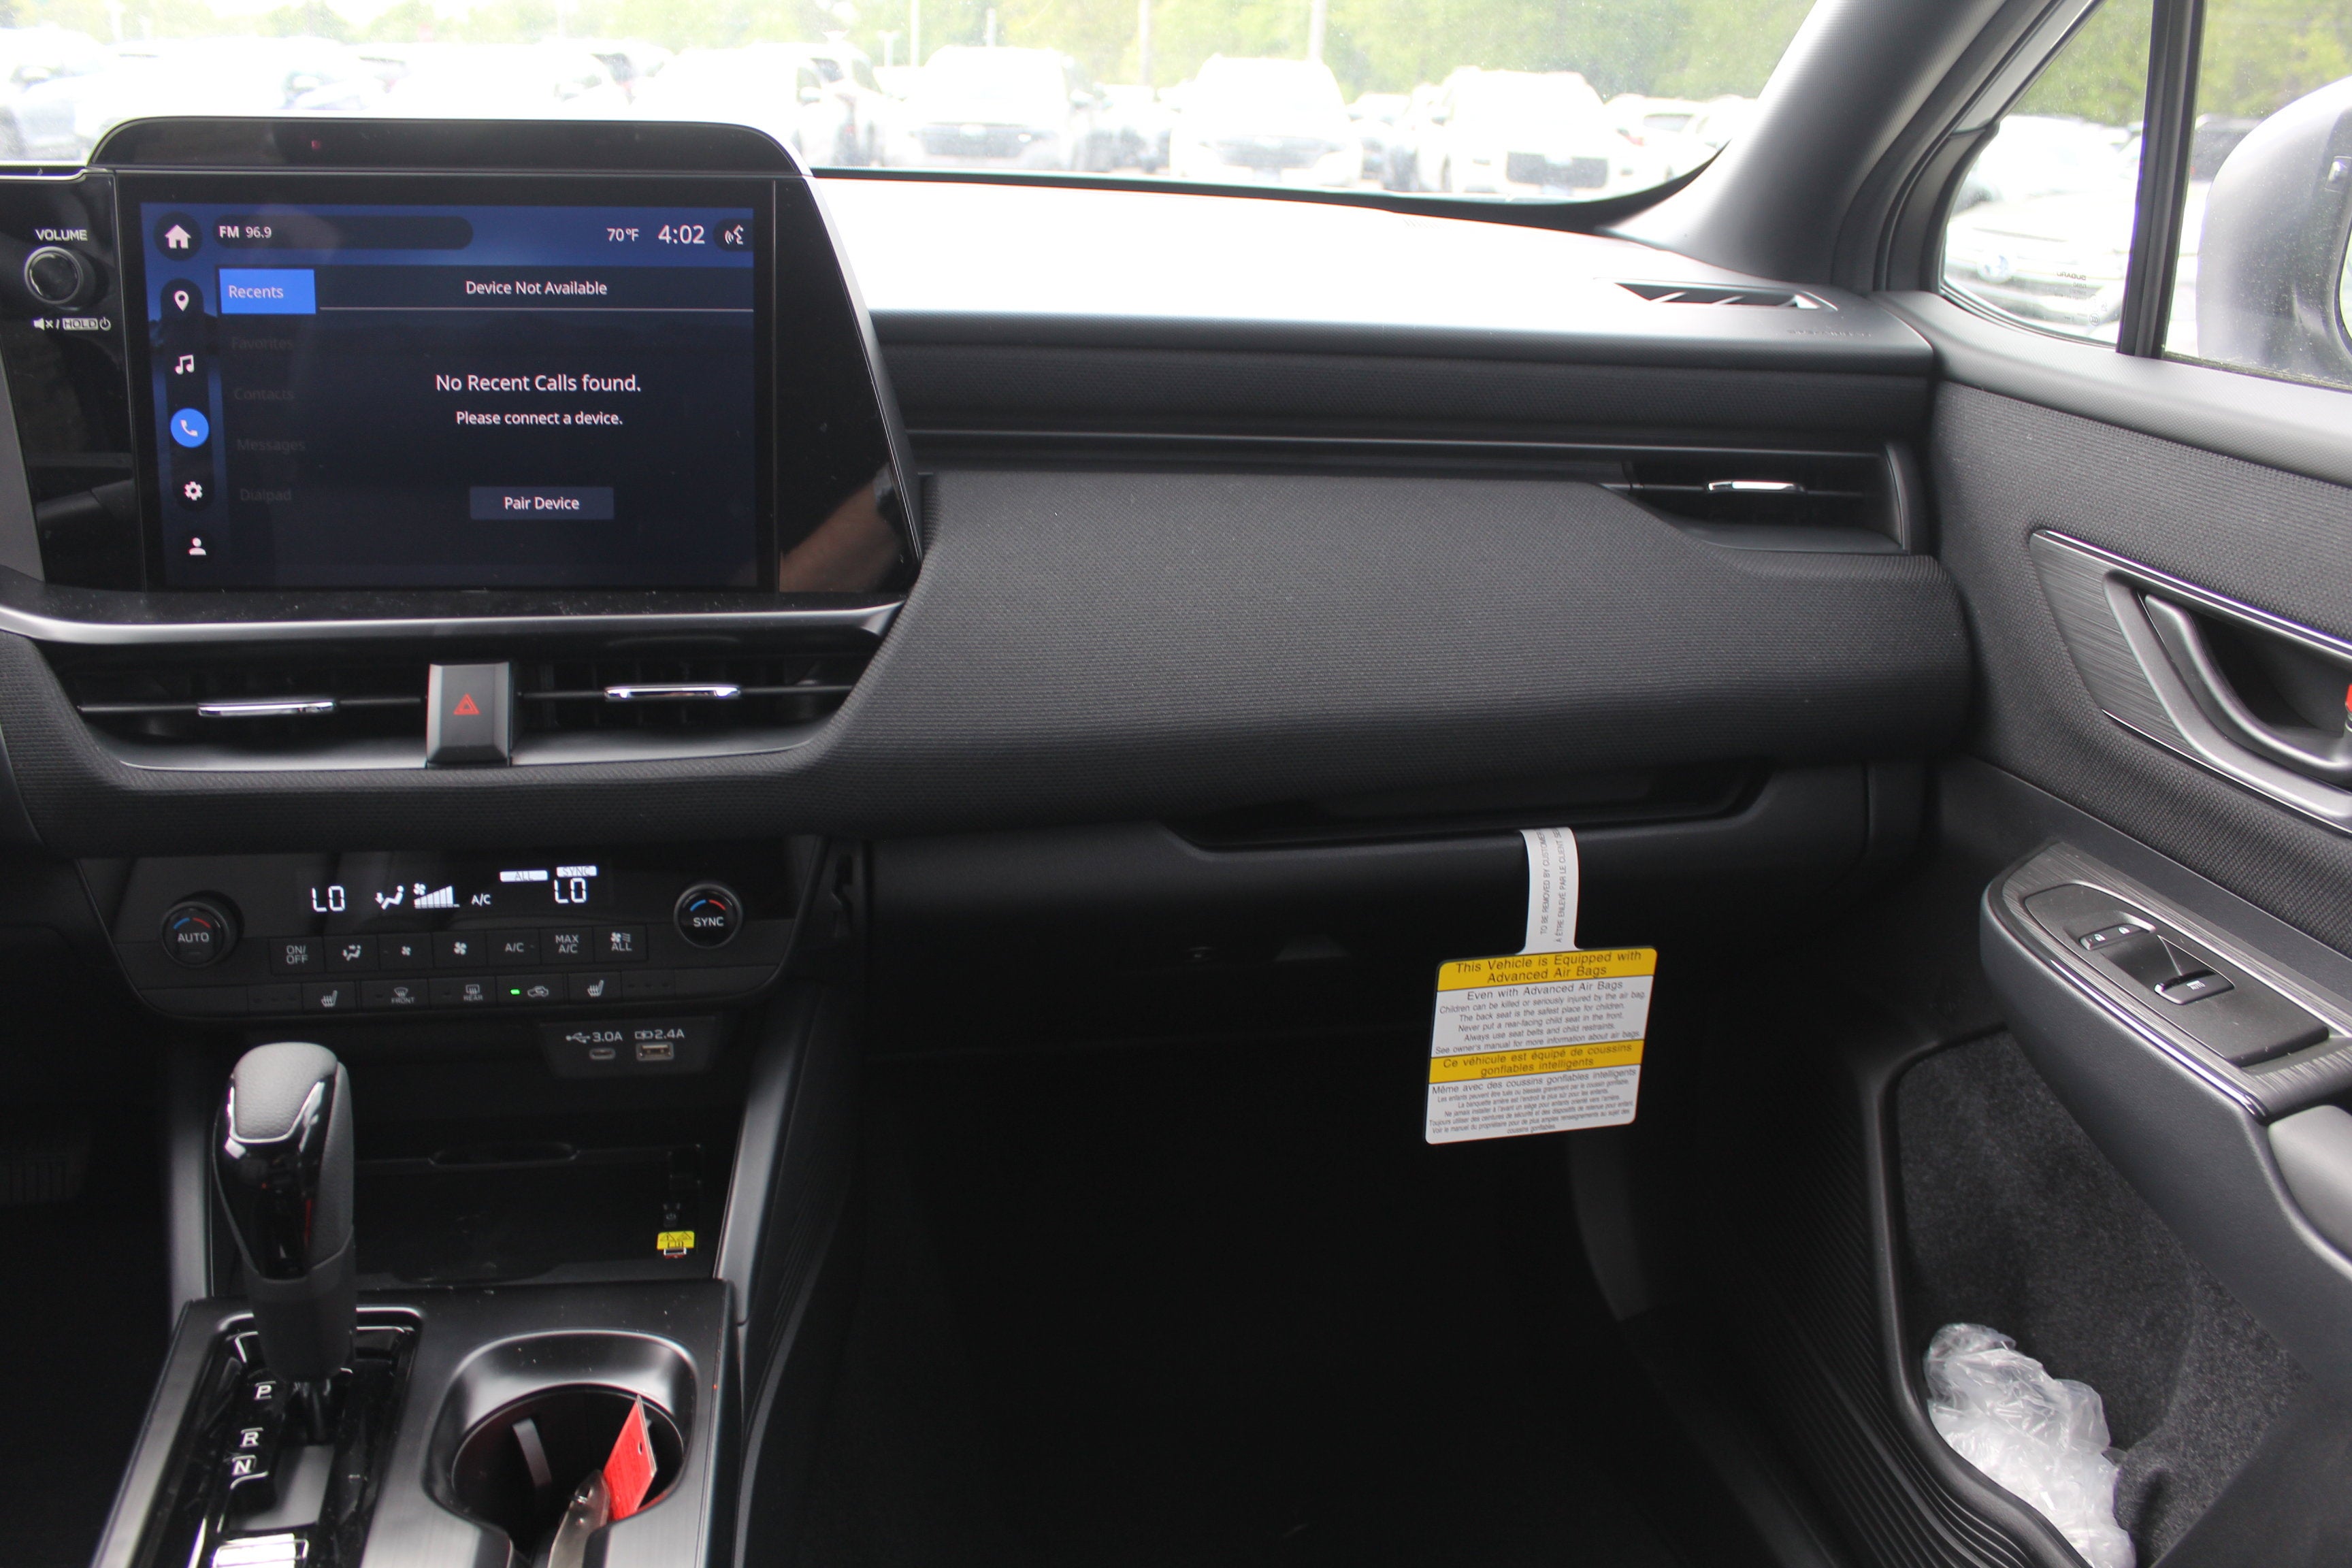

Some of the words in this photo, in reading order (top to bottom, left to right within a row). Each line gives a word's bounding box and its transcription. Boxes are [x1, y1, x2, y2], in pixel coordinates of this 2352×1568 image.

[35, 229, 88, 241] VOLUME
[219, 226, 239, 238] FM
[246, 226, 272, 239] 96.9
[607, 228, 639, 242] 70°F
[658, 225, 705, 244] 4:02
[228, 284, 284, 299] Recents
[466, 280, 512, 295] Device
[516, 282, 541, 295] Not
[544, 280, 607, 295] Available
[65, 319, 97, 329] HOLD
[231, 336, 294, 350] Favorites
[436, 374, 461, 391] No
[468, 375, 530, 391] Recent
[535, 374, 577, 391] Calls
[582, 374, 641, 391] found.
[233, 387, 295, 402] Contacts
[456, 411, 501, 425] Please
[504, 412, 559, 425] connect
[564, 415, 572, 425] a
[575, 411, 623, 425] device.
[237, 437, 306, 452] Messages
[240, 487, 292, 504] Dialpad
[504, 496, 531, 510] Pair
[535, 496, 579, 510] Device
[514, 872, 534, 881] ALL
[563, 866, 590, 877] SYNC
[471, 894, 492, 906] A/C
[693, 917, 724, 927] SYNC
[178, 932, 210, 943] AUTO
[555, 934, 579, 944] MAX
[287, 945, 306, 956] ON/
[505, 942, 524, 953] A/C
[559, 943, 578, 953] A/C
[611, 941, 632, 951] ALL
[287, 954, 308, 964] OFF
[1456, 962, 1481, 973] This
[1487, 958, 1532, 970] Vehicle
[1538, 956, 1548, 966] is
[1554, 951, 1612, 967] Equipped
[1617, 950, 1642, 961] with
[1487, 969, 1548, 983] Advanced
[1554, 968, 1570, 977] Air
[1576, 965, 1607, 979] Bags
[1467, 990, 1492, 1000] Even
[1498, 988, 1518, 997] with
[1523, 983, 1573, 995] Advanced
[1578, 982, 1592, 991] Air
[1597, 980, 1622, 992] Bags
[391, 996, 415, 1004] FRONT
[1439, 1004, 1469, 1013] Children
[1533, 997, 1563, 1007] seriously
[1567, 995, 1590, 1004] injured
[1561, 1005, 1581, 1014] place
[1482, 1023, 1494, 1031] put
[592, 1032, 623, 1042] 3.0A
[655, 1029, 685, 1040] 2.4A
[1464, 1033, 1489, 1043] Always
[1484, 1041, 1509, 1049] manual
[1546, 1034, 1585, 1043] information
[1443, 1058, 1458, 1068] Ce
[1463, 1054, 1506, 1066] véhicule
[1511, 1052, 1527, 1062] est
[1531, 1048, 1565, 1061] équipé
[1570, 1047, 1583, 1056] de
[1587, 1043, 1632, 1054] coussins
[1480, 1063, 1534, 1077] gonflables
[1538, 1058, 1594, 1072] intelligents
[255, 1385, 272, 1399] P
[242, 1432, 259, 1446] R
[233, 1460, 251, 1474] N
